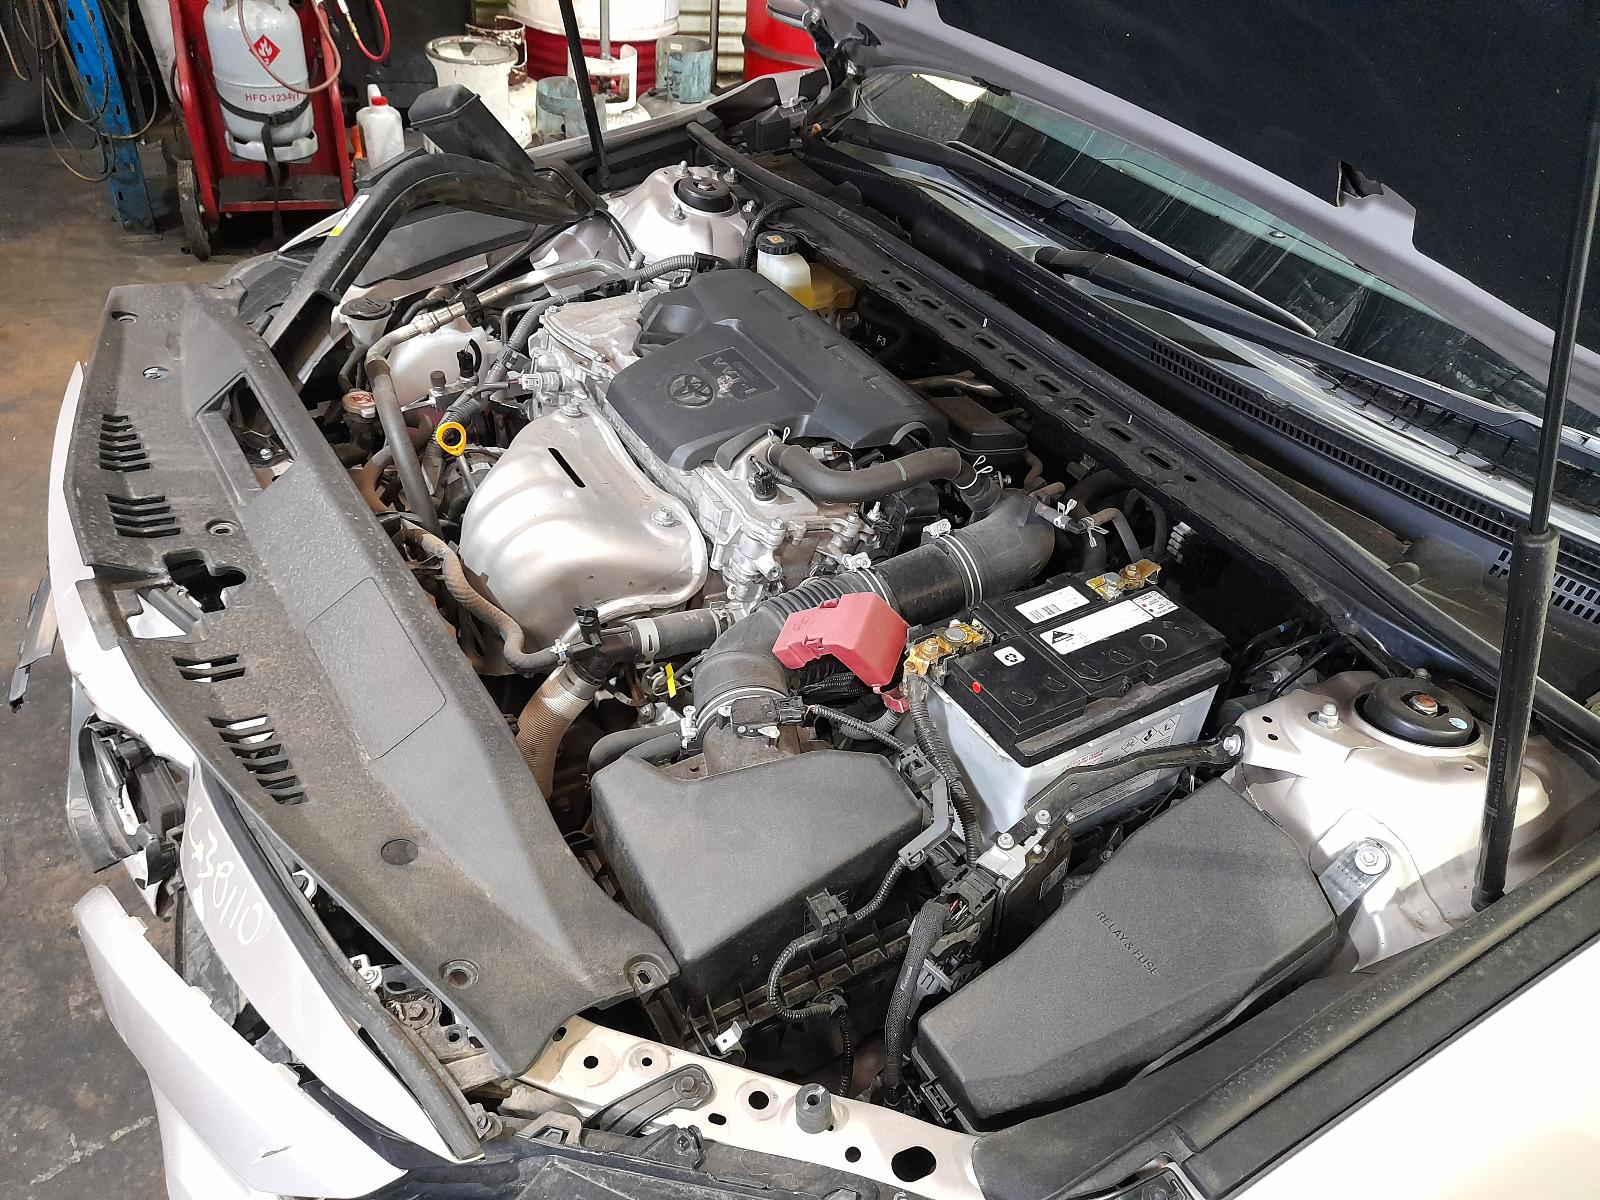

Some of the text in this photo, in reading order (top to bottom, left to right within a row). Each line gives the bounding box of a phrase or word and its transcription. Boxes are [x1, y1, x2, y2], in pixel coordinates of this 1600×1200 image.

[1096, 911, 1159, 977] RELAY & FUSE
